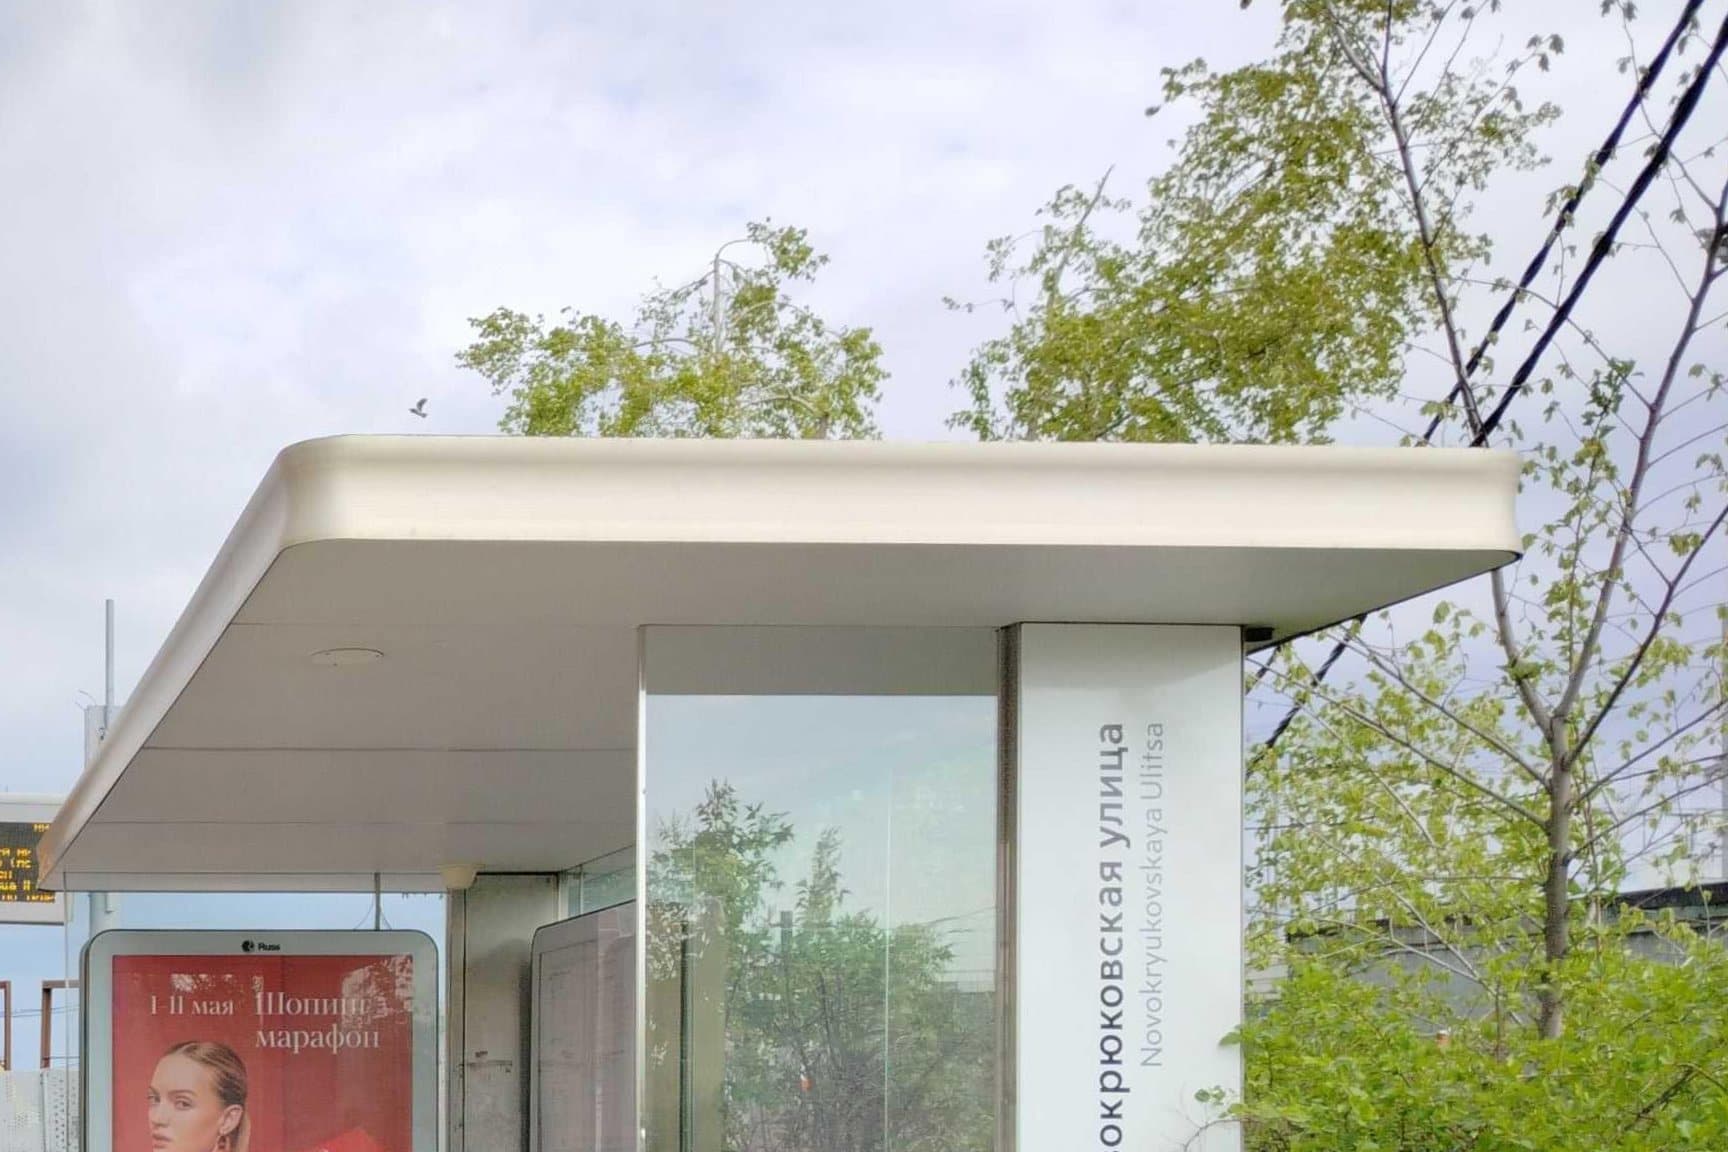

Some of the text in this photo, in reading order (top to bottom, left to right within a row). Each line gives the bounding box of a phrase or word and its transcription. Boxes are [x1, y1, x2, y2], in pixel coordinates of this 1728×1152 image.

[1099, 723, 1131, 849] улица
[1139, 722, 1168, 1067] Novokryukovskaya Ulitsa
[191, 999, 235, 1015] мая
[256, 1023, 380, 1054] марафон
